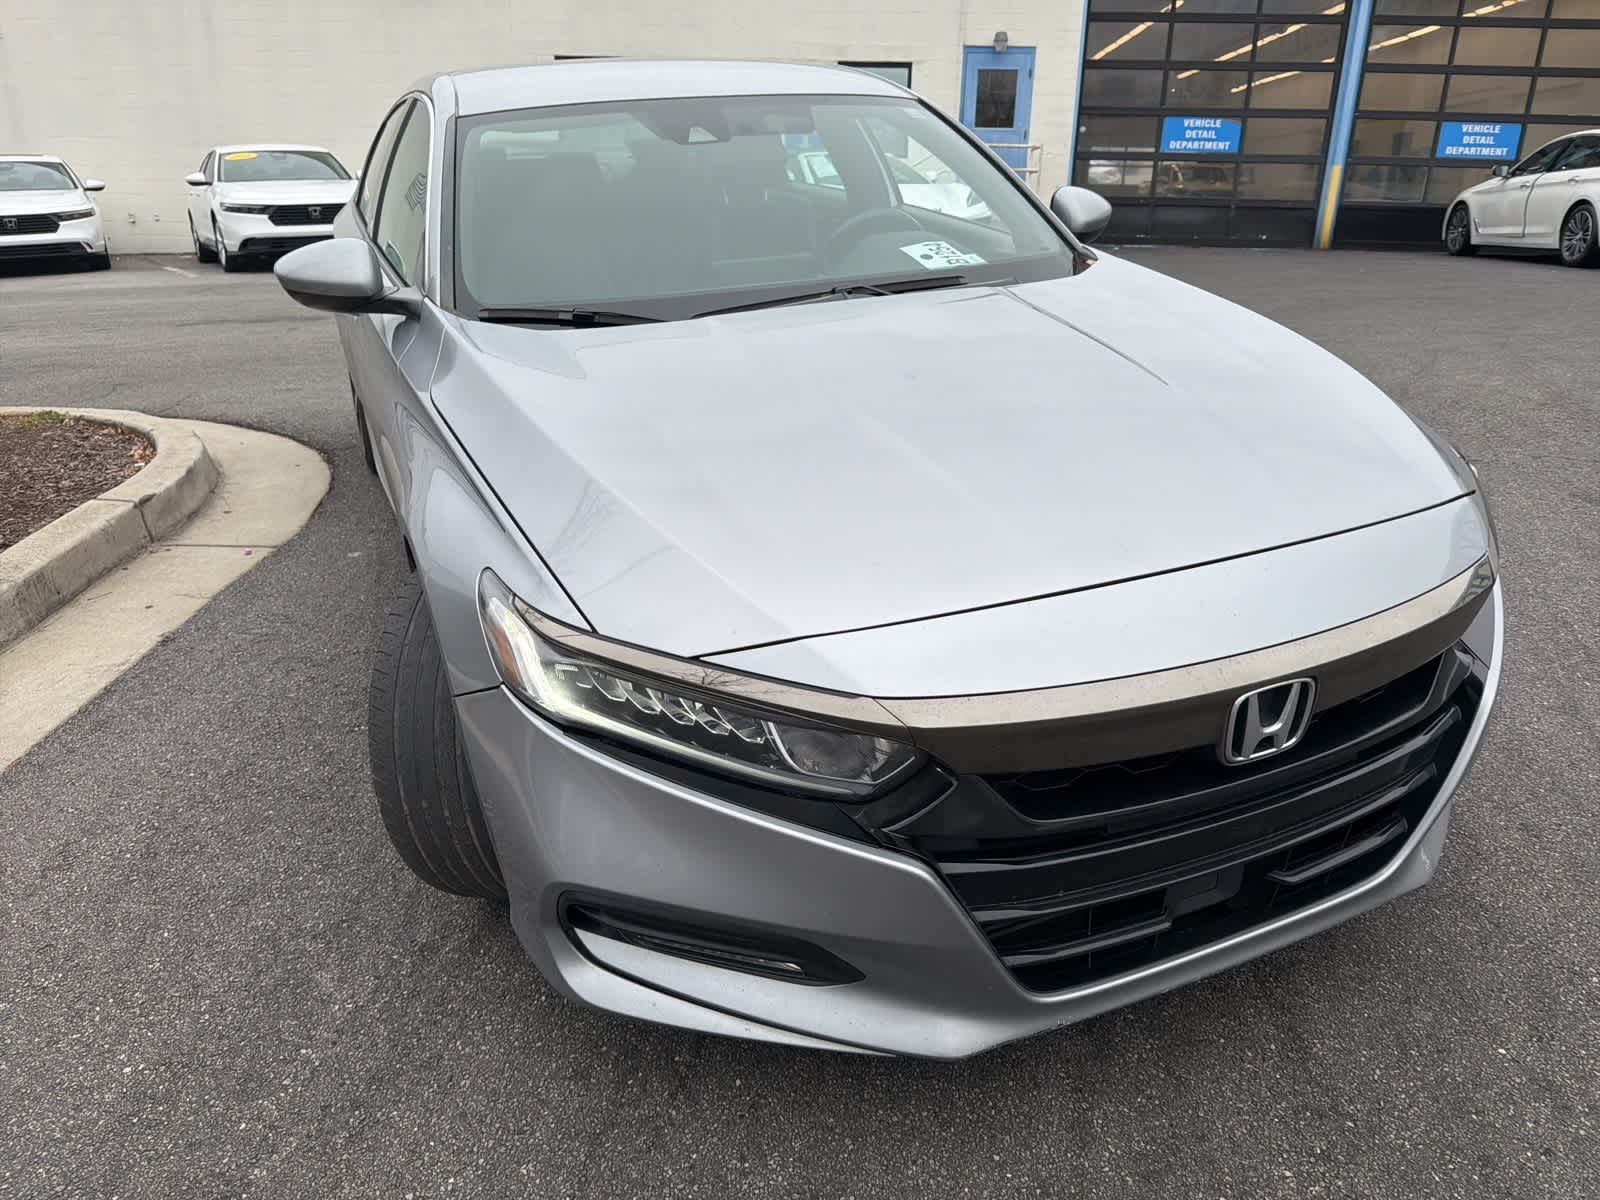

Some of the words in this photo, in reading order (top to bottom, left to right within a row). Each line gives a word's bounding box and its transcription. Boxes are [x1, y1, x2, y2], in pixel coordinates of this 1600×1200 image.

[1183, 118, 1223, 128] VEHICLE
[1184, 129, 1218, 139] DETAIL
[1460, 124, 1502, 134] VEHICLE
[1462, 135, 1496, 145] DETAIL
[1168, 140, 1232, 151] DEPARTMENT
[1444, 146, 1509, 156] DEPARTMENT
